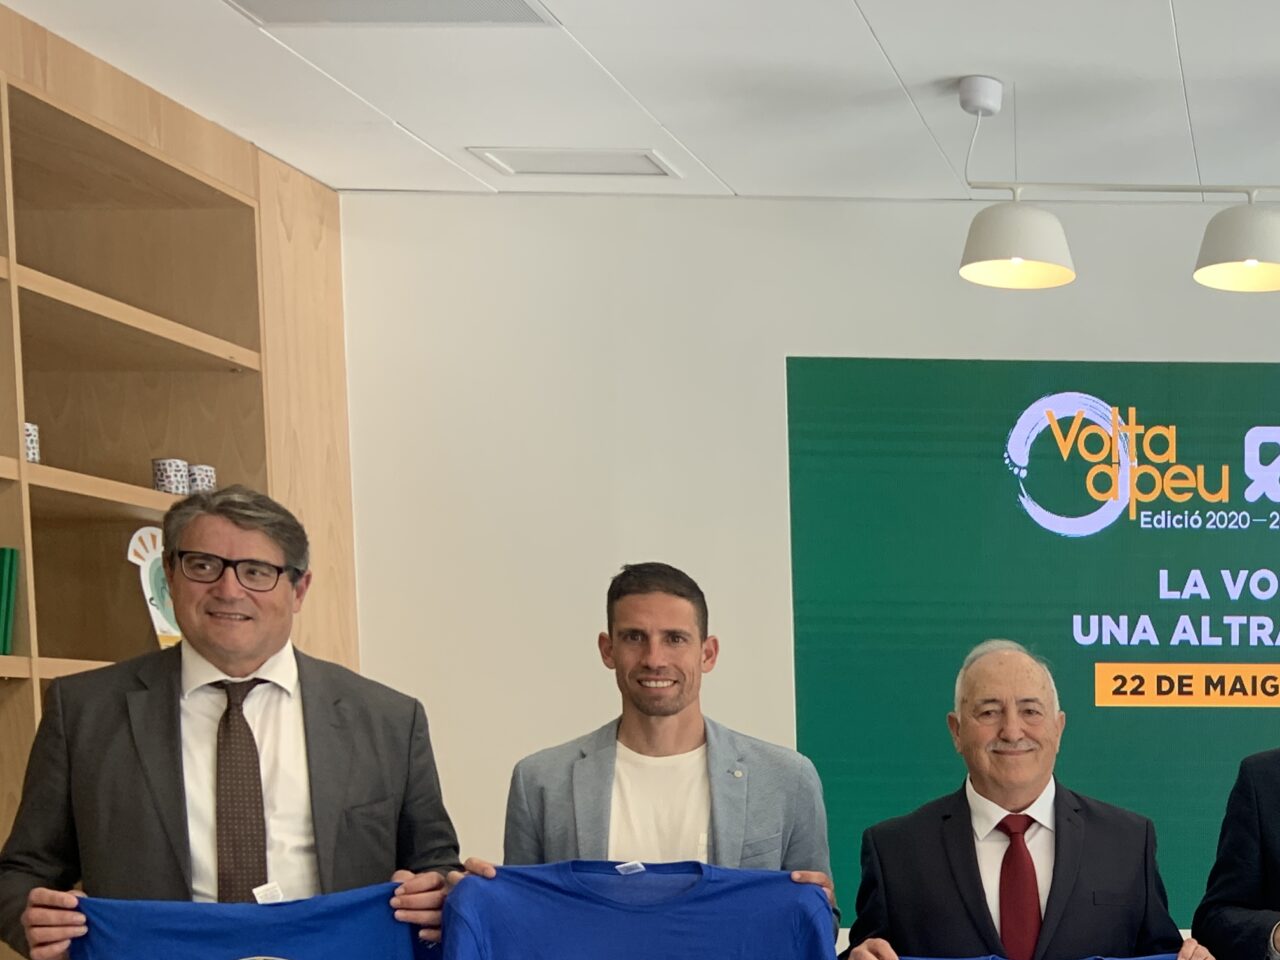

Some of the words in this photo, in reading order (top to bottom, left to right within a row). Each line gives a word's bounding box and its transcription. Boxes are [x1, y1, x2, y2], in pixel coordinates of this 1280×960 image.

[1045, 406, 1176, 463] Volta
[1140, 511, 1202, 529] Edició
[1159, 569, 1210, 600] LA
[1072, 615, 1159, 646] UNA
[1112, 674, 1145, 696] 22
[1157, 675, 1193, 696] DE
[1205, 674, 1279, 697] MAIG
